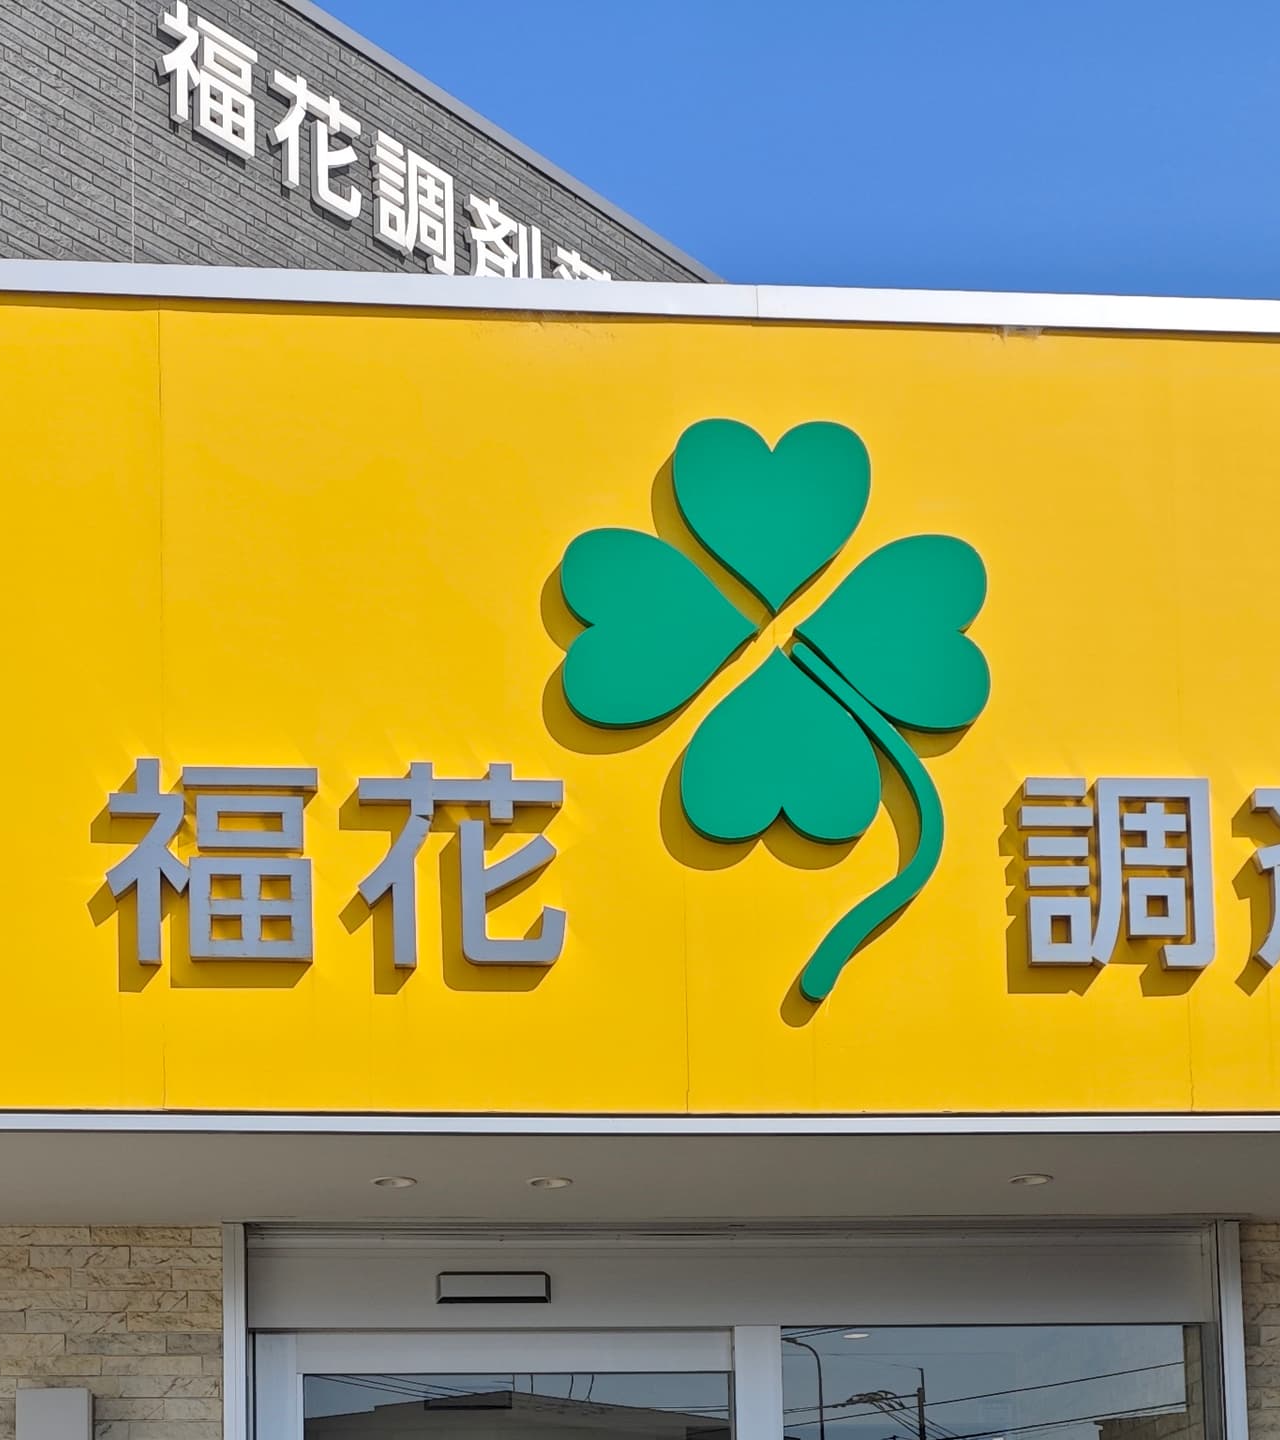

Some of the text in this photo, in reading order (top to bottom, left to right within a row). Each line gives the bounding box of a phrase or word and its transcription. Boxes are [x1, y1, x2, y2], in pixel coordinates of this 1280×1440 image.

[158, 0, 611, 280] 福花調剤
[106, 758, 566, 968] 福花
